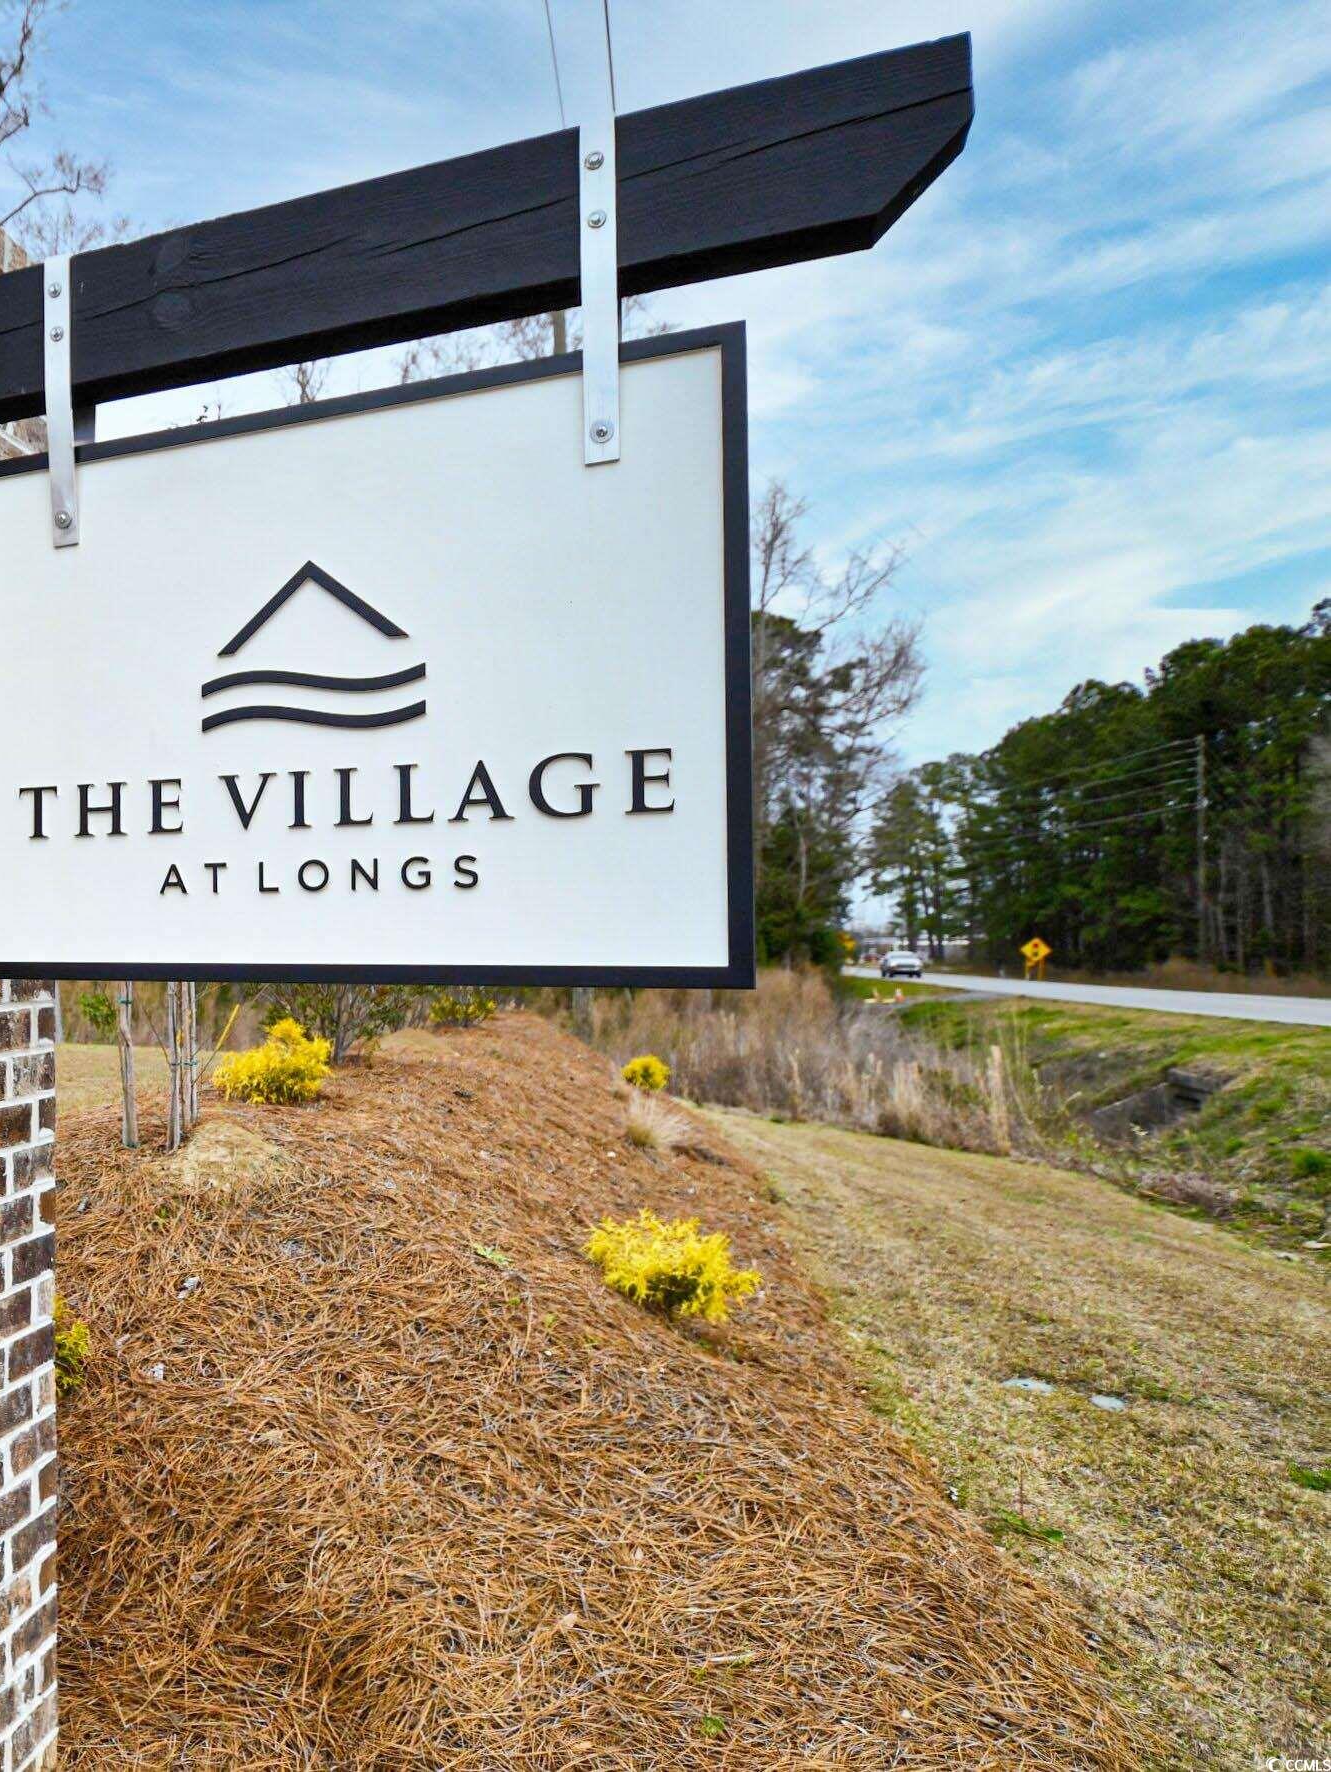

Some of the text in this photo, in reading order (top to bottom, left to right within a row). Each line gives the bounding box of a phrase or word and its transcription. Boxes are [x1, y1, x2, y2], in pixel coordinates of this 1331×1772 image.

[18, 747, 676, 840] THE VILLAGE
[159, 854, 480, 895] AT LONGS
